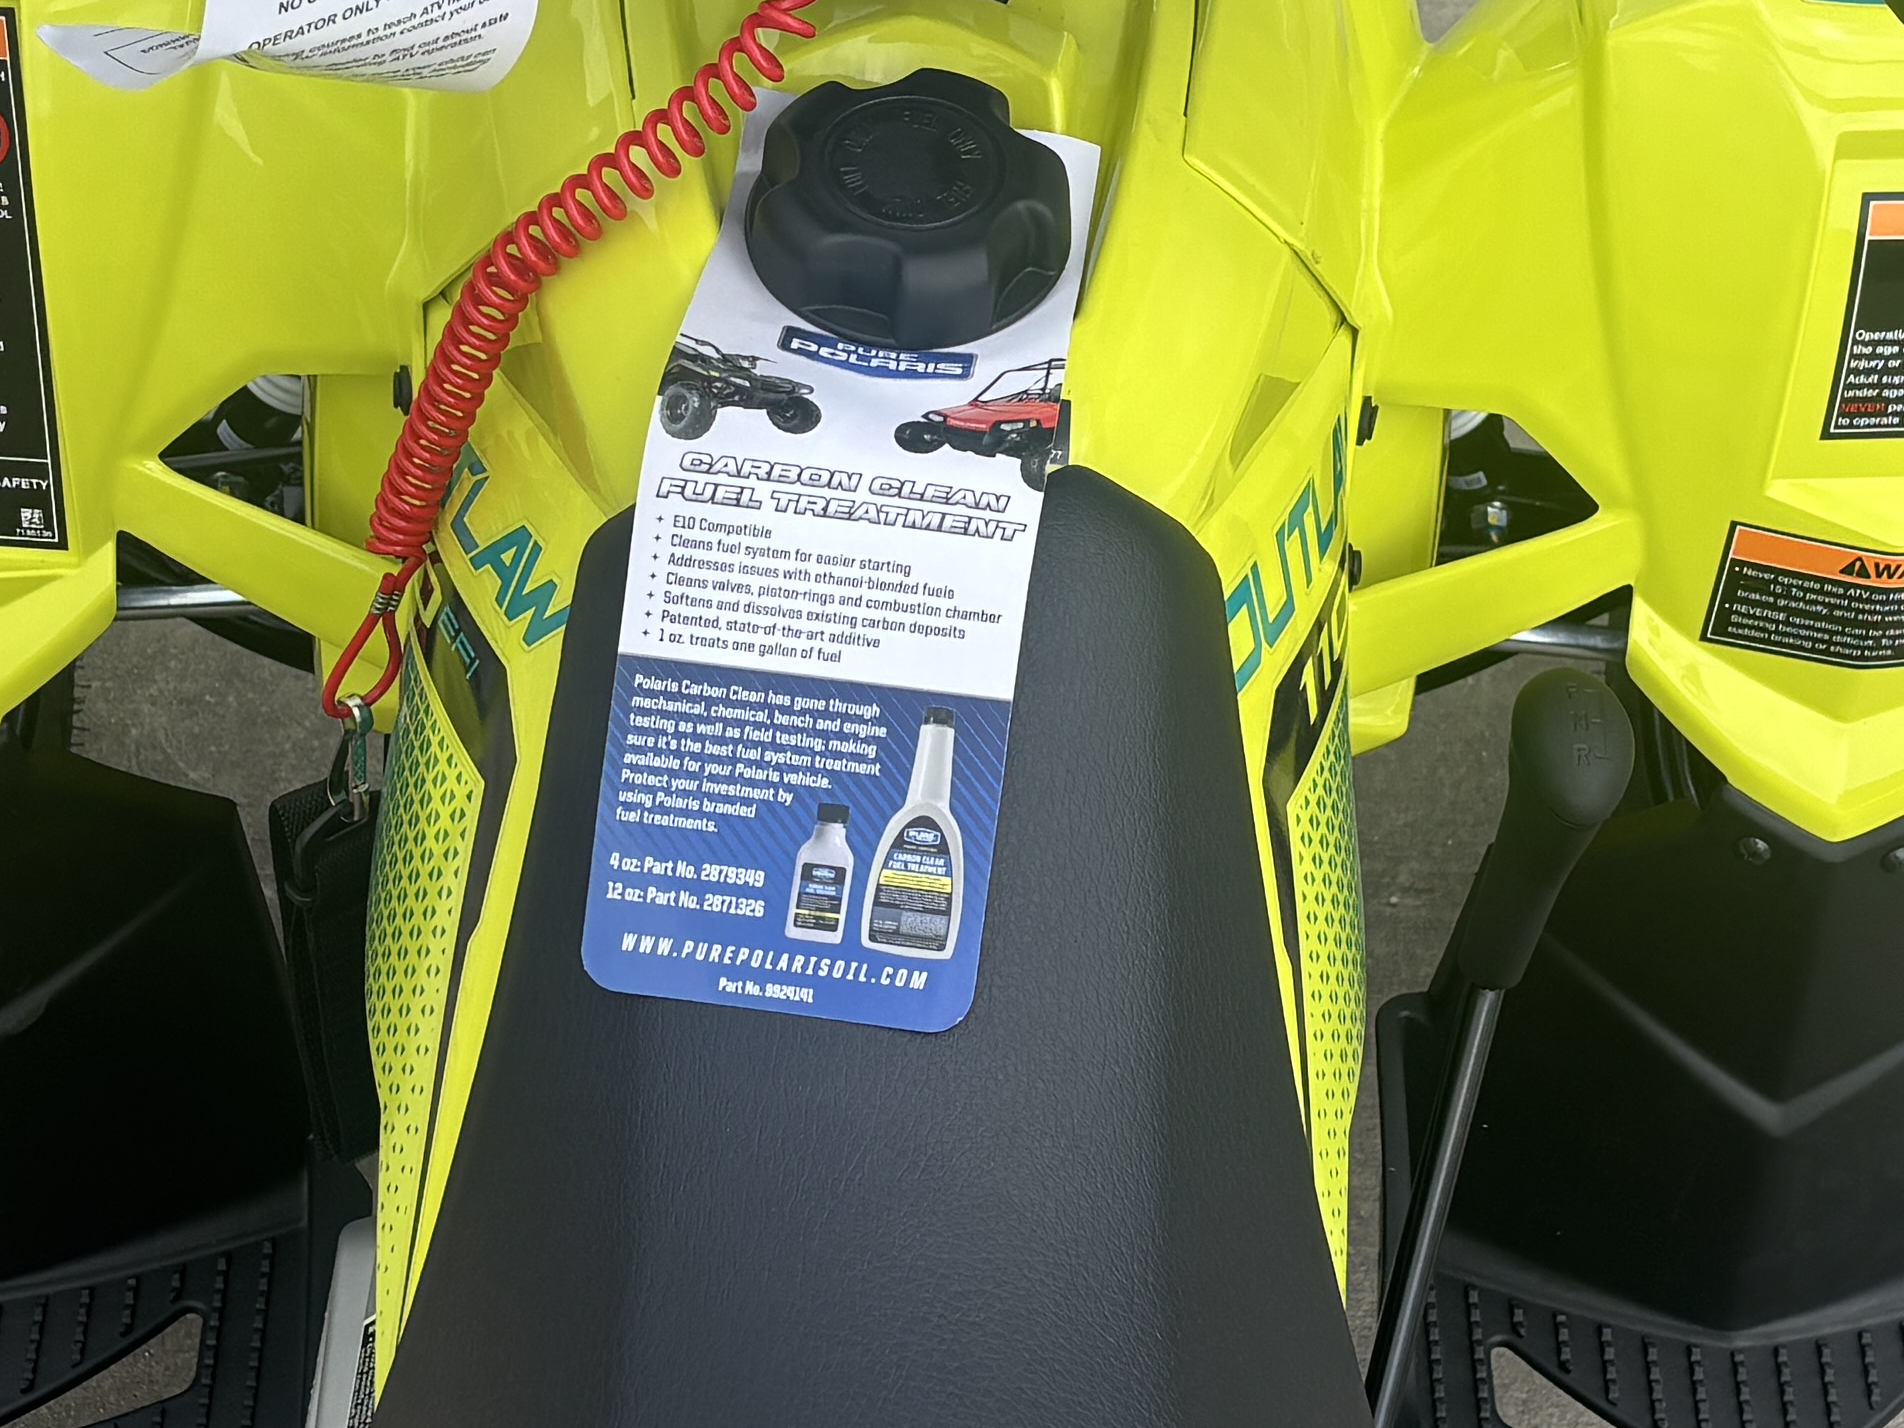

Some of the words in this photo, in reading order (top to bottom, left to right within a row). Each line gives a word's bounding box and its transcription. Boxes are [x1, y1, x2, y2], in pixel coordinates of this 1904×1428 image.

[247, 13, 337, 52] OPERATOR
[790, 338, 964, 375] POLARIS
[837, 342, 919, 361] PURE
[679, 451, 863, 493] CARBON
[868, 476, 1011, 513] CLEAN
[656, 477, 763, 510] FUEL
[771, 489, 1027, 542] TREATMENT
[672, 513, 696, 530] E10
[698, 517, 772, 539] Compatible
[670, 533, 713, 551] Cleans
[716, 538, 742, 555] fuel
[743, 545, 791, 561] system
[794, 547, 812, 563] for
[815, 553, 856, 568] easier
[858, 557, 912, 578] starting
[438, 604, 480, 679] EFI
[658, 627, 665, 642] 1
[689, 633, 729, 650] treats
[731, 640, 755, 653] one
[758, 641, 797, 658] gallon
[800, 645, 814, 659] of
[816, 646, 842, 663] fuel
[633, 672, 679, 693] Polaris
[680, 679, 727, 699] Carbon
[728, 684, 765, 703] Clean
[766, 689, 791, 706] has
[792, 696, 826, 711] gone
[828, 697, 880, 719] through
[630, 695, 708, 717] mechanical,
[709, 702, 771, 725] chemical,
[772, 709, 814, 729] bench
[815, 717, 841, 732] and
[842, 721, 887, 738] engine
[1573, 743, 1592, 767] R
[608, 851, 620, 870] 4
[620, 857, 641, 872] oz:
[642, 855, 674, 876] Part
[674, 859, 697, 879] No.
[700, 862, 765, 888] 2879349
[605, 880, 623, 900] 12
[623, 887, 644, 902] oz:
[645, 885, 676, 907] Part
[677, 889, 700, 910] No.
[702, 893, 765, 917] 2871326
[620, 931, 928, 990] WWW.PUREPOLARISOIL.COM
[717, 976, 743, 994] Part
[743, 979, 763, 996] No.
